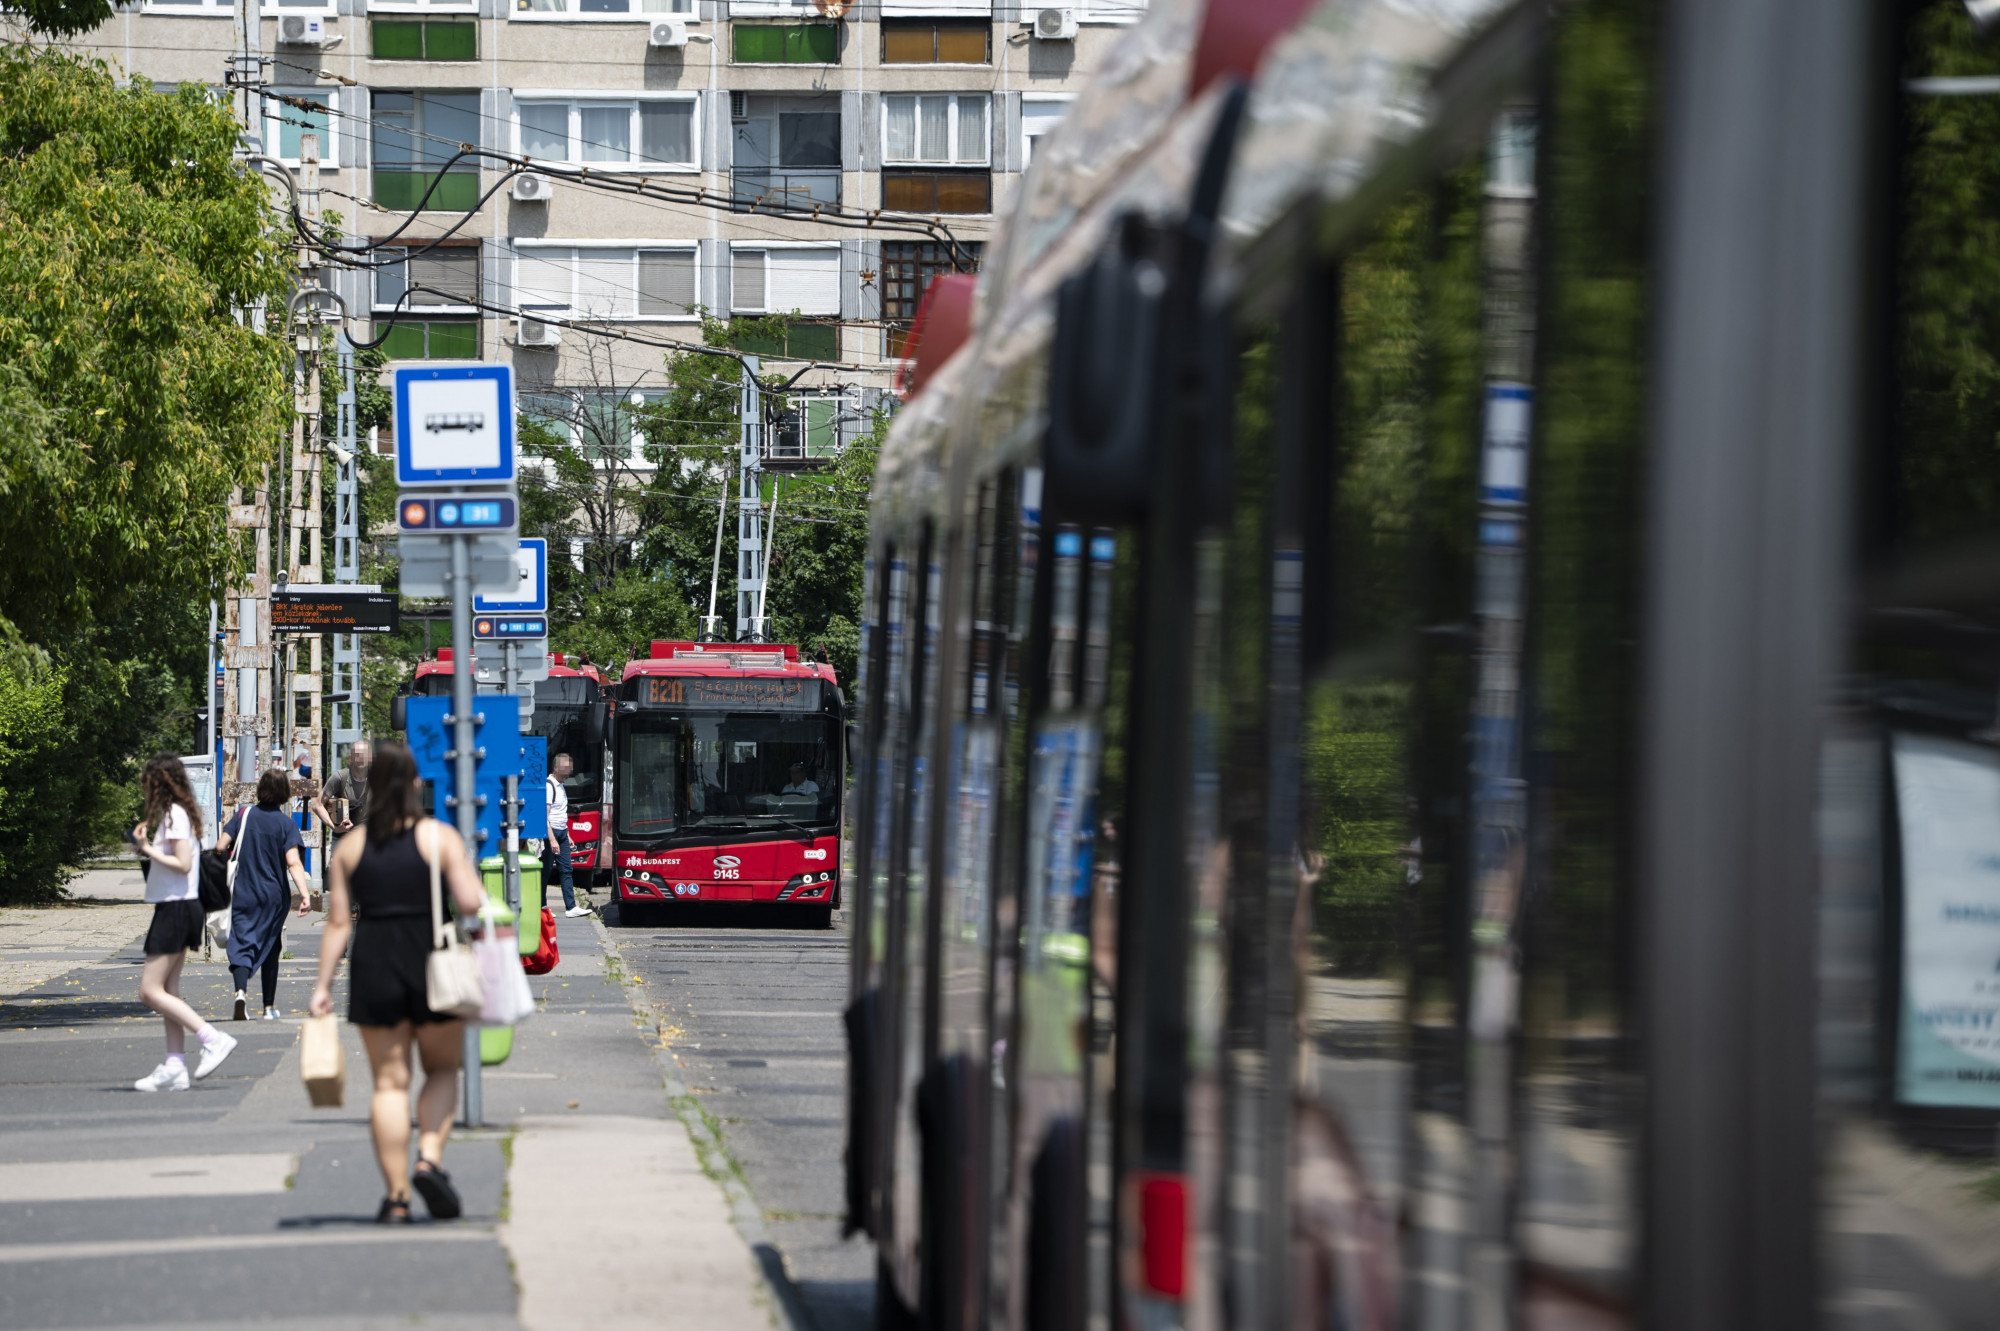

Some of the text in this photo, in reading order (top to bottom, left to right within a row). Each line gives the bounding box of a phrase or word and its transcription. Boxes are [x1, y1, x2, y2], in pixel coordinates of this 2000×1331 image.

[472, 506, 489, 520] 31
[650, 679, 682, 702] 82A
[642, 858, 681, 866] BUDAPEST
[713, 869, 740, 880] 9145
